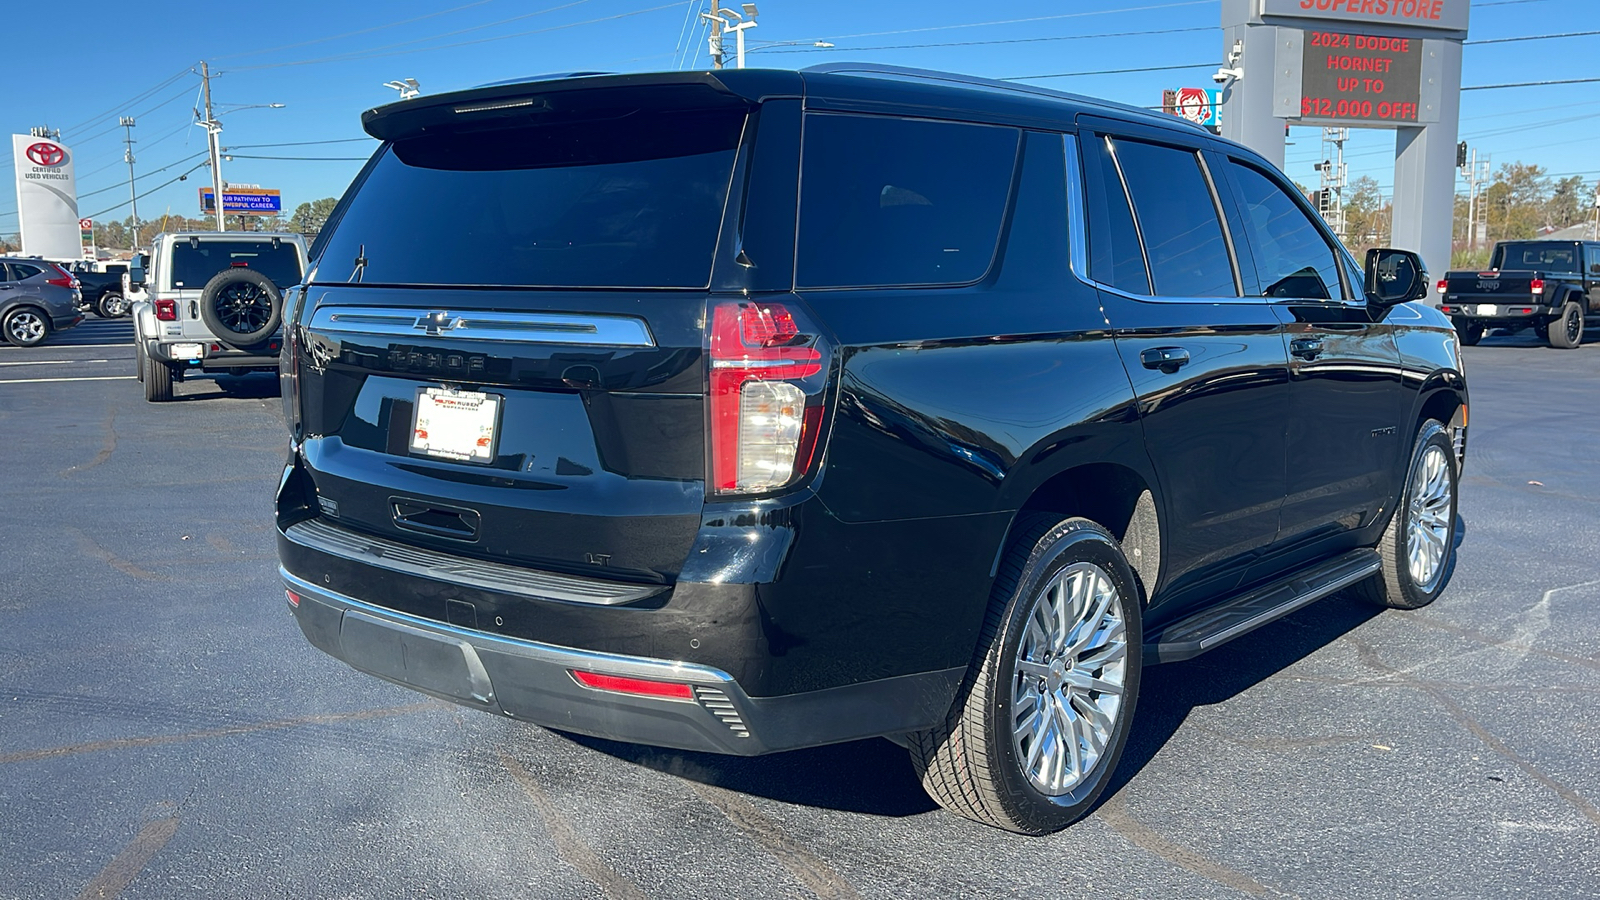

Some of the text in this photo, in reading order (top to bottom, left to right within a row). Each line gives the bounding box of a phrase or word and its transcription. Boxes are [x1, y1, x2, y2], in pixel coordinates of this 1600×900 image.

[1299, 0, 1443, 20] SUPERSTORE
[1311, 32, 1410, 52] 2024 DODGE
[1327, 55, 1393, 73] HORNET
[1337, 77, 1384, 94] UP TO
[1301, 96, 1417, 120] $12,000 OFF!
[32, 166, 61, 174] CERTIFIED
[42, 173, 69, 181] VEHICLES
[1476, 280, 1500, 291] Jeep
